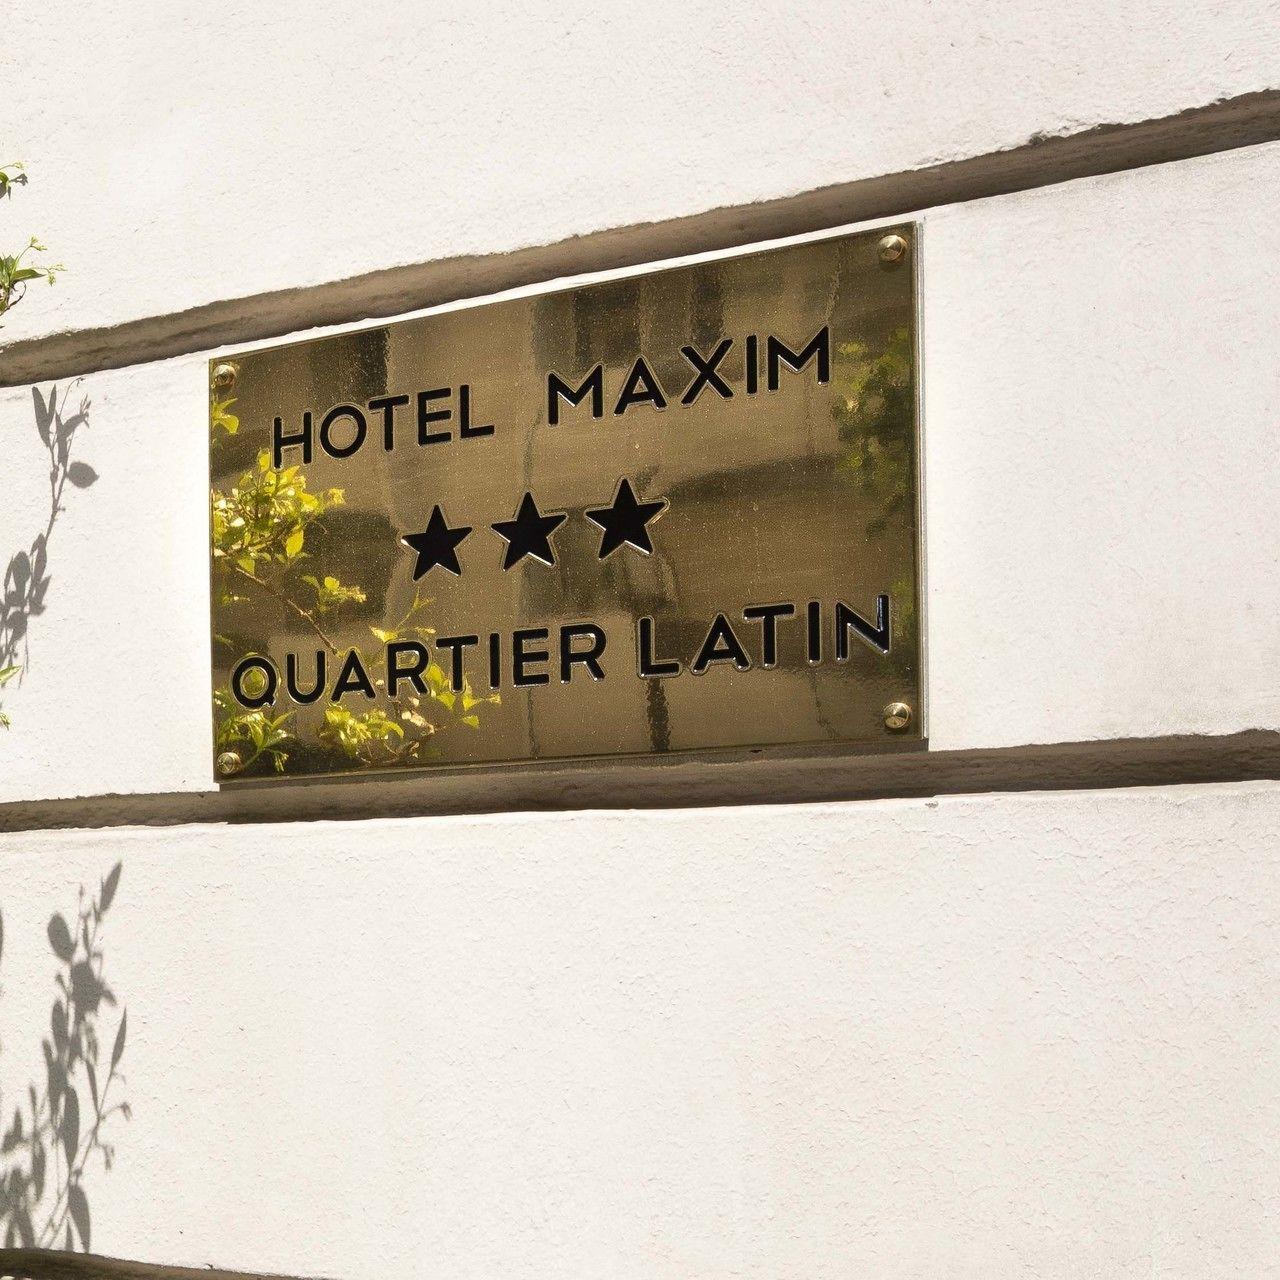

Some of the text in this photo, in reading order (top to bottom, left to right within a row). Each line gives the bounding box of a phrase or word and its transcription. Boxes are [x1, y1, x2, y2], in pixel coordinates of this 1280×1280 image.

[271, 325, 832, 469] HOTEL MAXIM
[231, 593, 893, 709] QUARTIER LATIN
